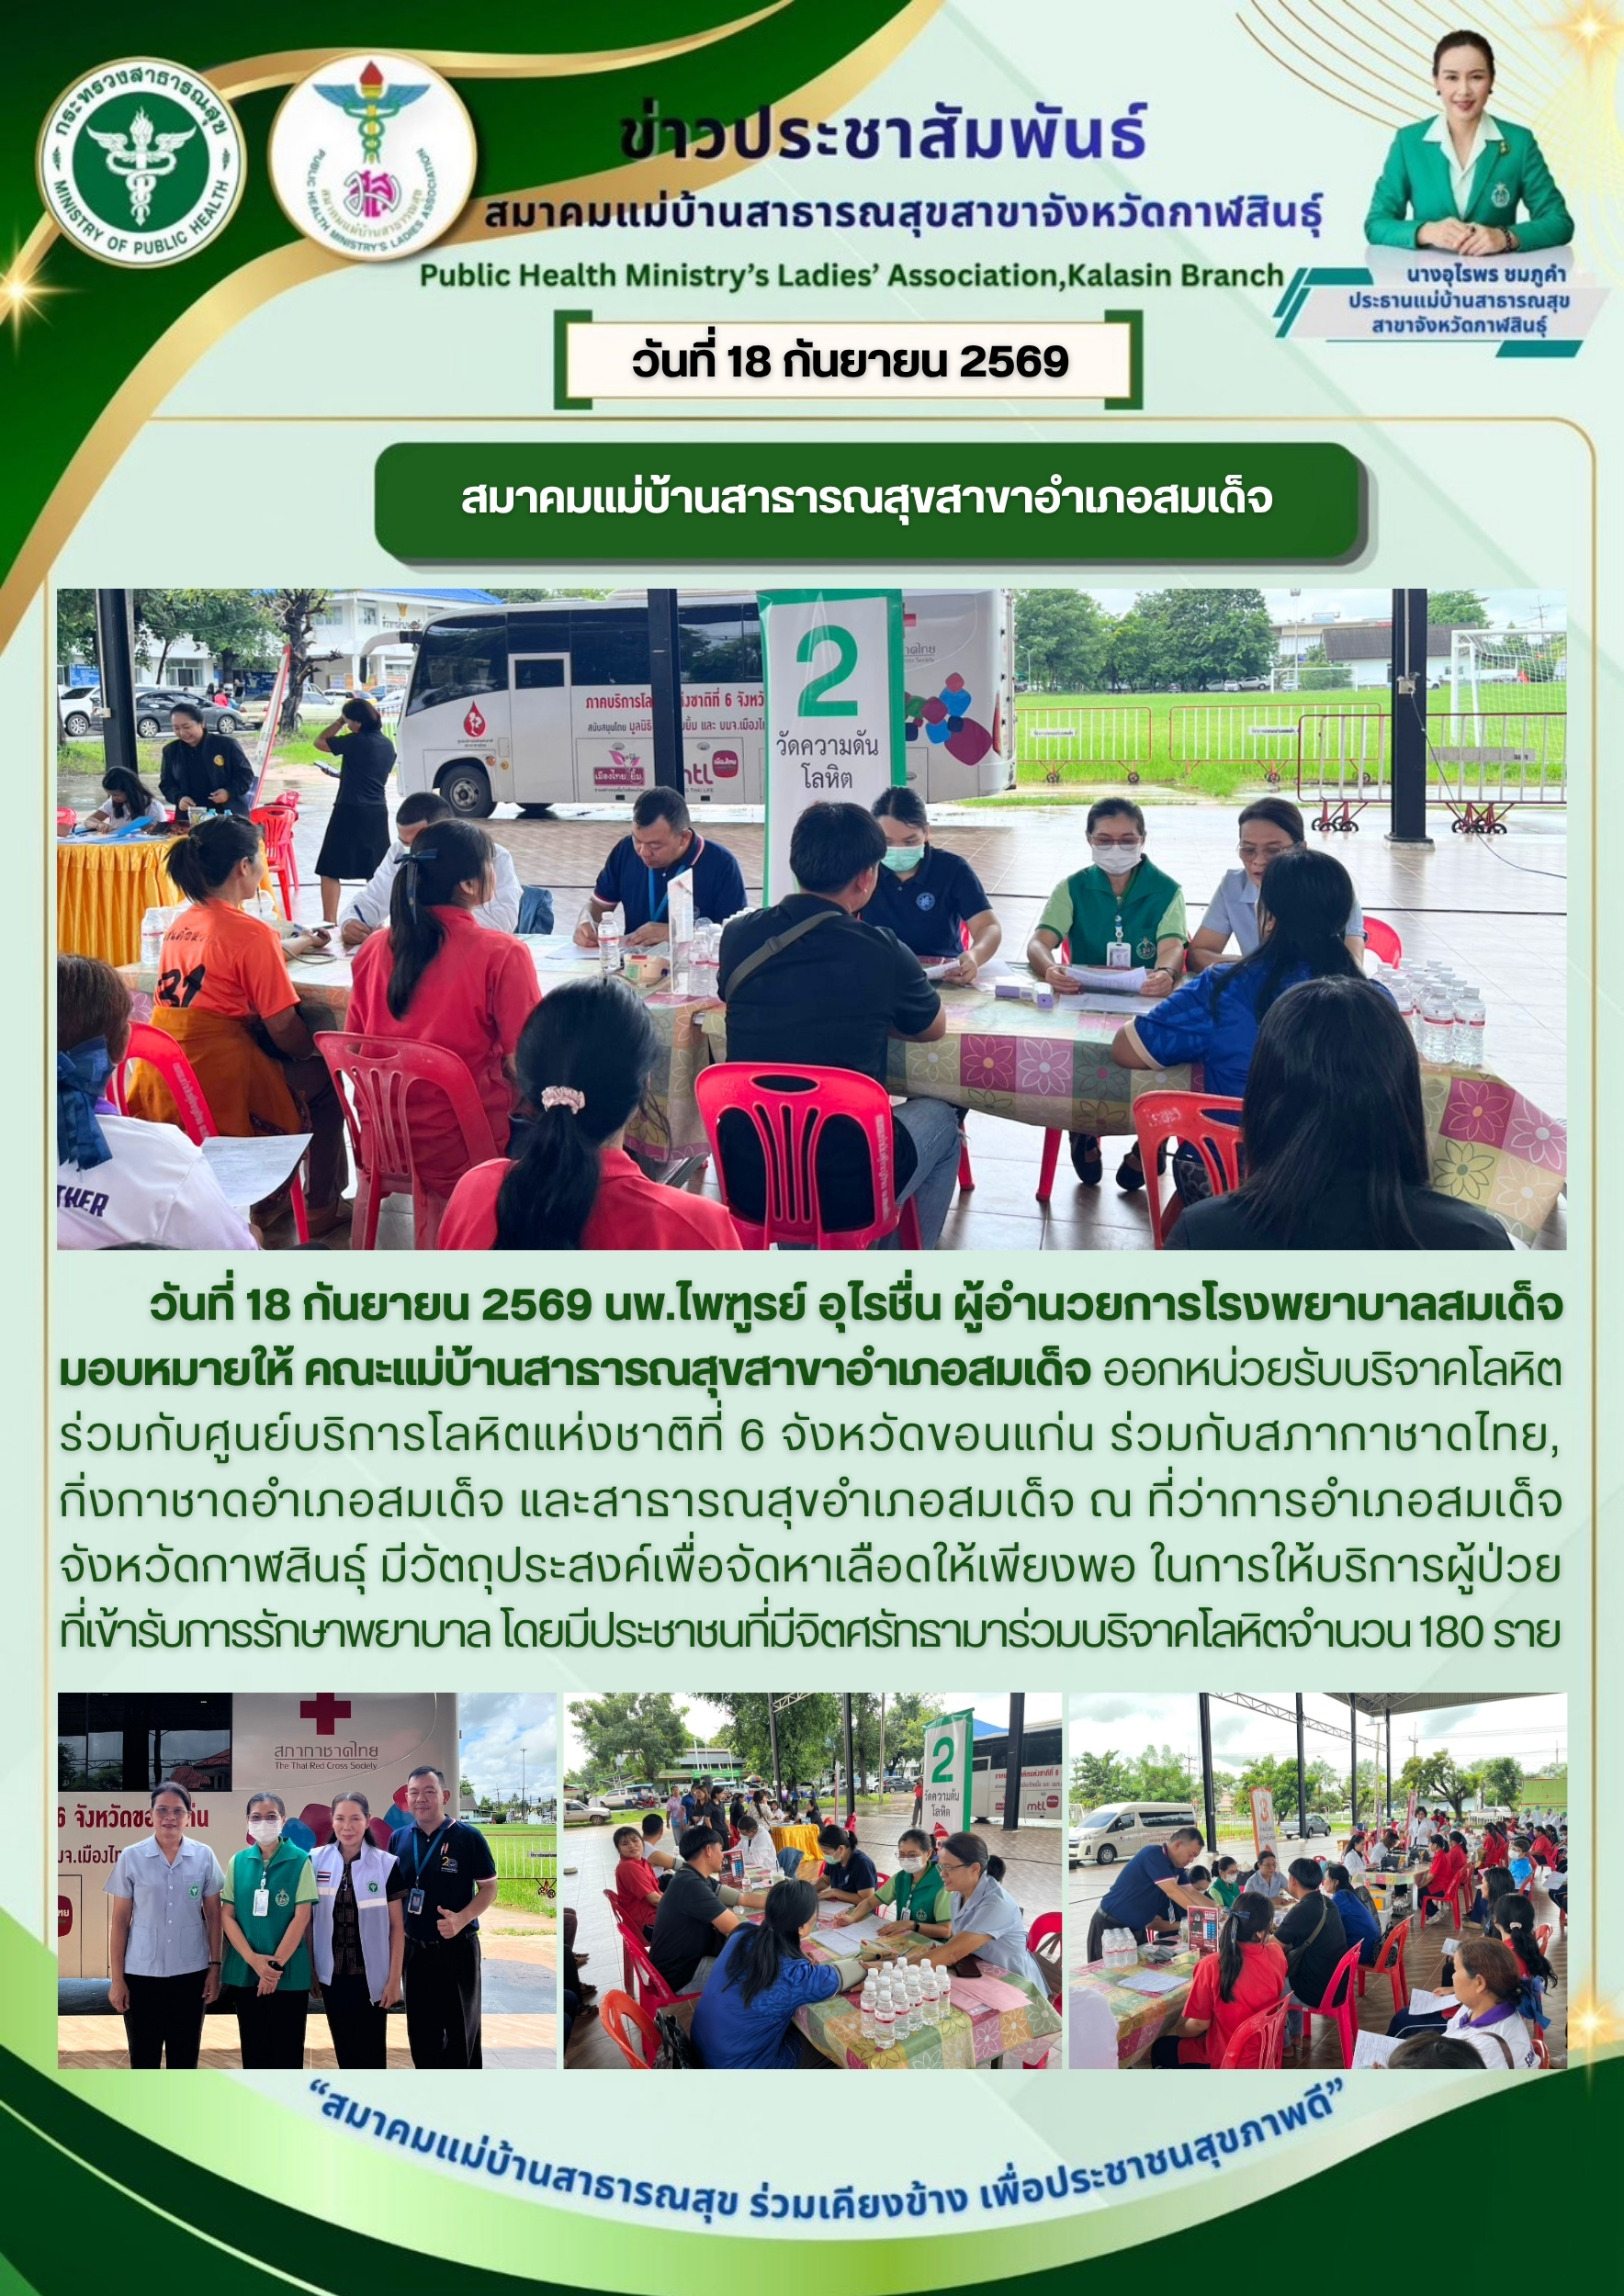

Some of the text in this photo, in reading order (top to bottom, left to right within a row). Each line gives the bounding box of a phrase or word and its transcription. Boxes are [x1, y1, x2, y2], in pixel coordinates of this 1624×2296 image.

[796, 625, 858, 716] 2
[725, 692, 732, 707] 6
[737, 691, 764, 707] จังหวั
[701, 720, 716, 731] และ
[776, 730, 879, 757] วัดความดัน
[801, 763, 853, 789] โลหิต
[274, 1740, 378, 1758] สภากาชาดไทย
[275, 1761, 378, 1772] The Thai Red Cross Society
[930, 1736, 954, 1784] 2
[924, 1788, 960, 1802] วัดความดัน
[930, 1804, 951, 1818] โลหิต
[1026, 1801, 1047, 1811] mtl
[1259, 1797, 1269, 1823] 3
[74, 1803, 154, 1828] จังหวัดขอ
